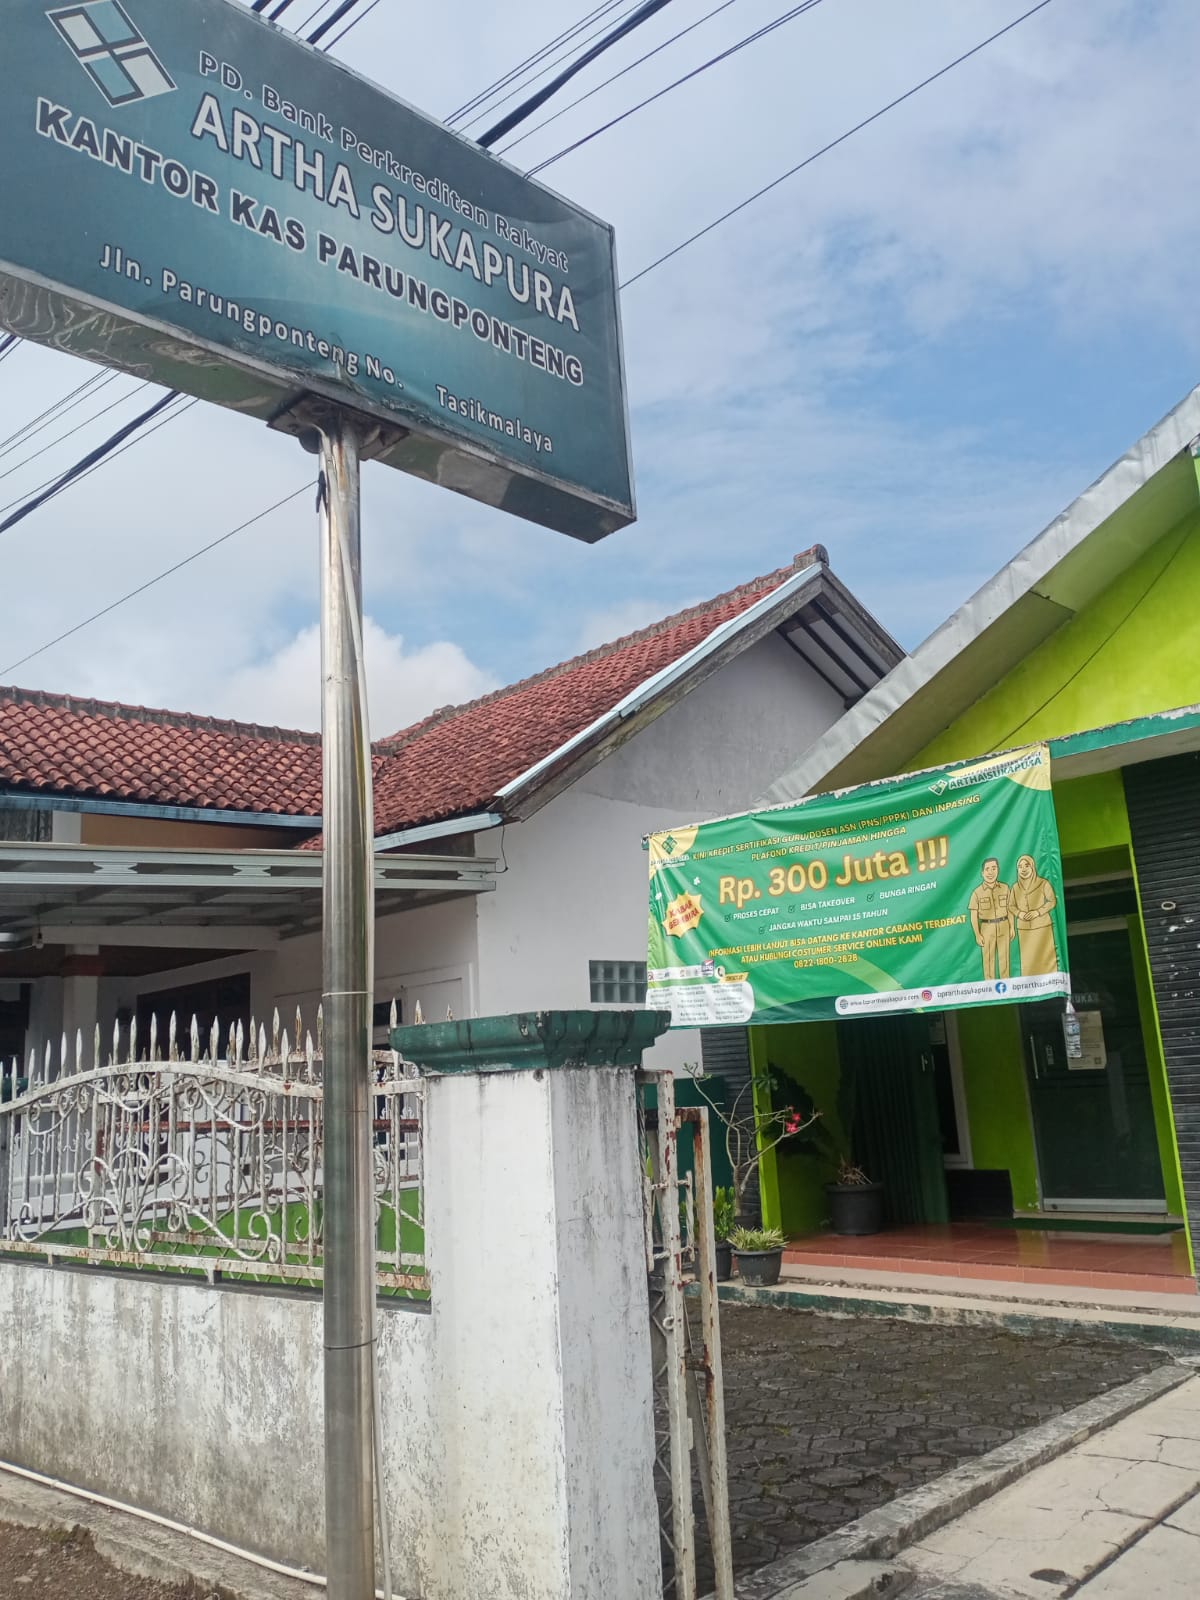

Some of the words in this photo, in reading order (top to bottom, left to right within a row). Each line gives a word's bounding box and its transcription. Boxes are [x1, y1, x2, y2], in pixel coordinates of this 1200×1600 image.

[199, 50, 254, 100] PD.
[261, 84, 334, 143] Bank
[340, 127, 489, 228] Perkreditan
[494, 214, 569, 273] Rakyat
[190, 91, 361, 220] ARTHA
[370, 182, 581, 333] SUKAPURA
[36, 96, 220, 215] KANTOR
[229, 187, 307, 253] KAS
[316, 231, 584, 386] PARUNGPONTENG
[99, 243, 152, 287] Jln.
[161, 268, 359, 376] Parungponteng
[365, 354, 404, 389] No.
[436, 383, 554, 454] Tasikmalaya
[709, 847, 735, 857] KREDIT
[735, 836, 780, 852] SERTIFIKASI
[782, 829, 838, 843] GURU/DOSEN
[839, 823, 857, 833] ASN
[858, 811, 910, 830] (PNS/PPPK)
[912, 806, 933, 818] DAN
[935, 794, 981, 813] INPASING
[751, 847, 787, 861] PLAFOND
[788, 834, 869, 854] KREDIT/PINJAMAN
[870, 826, 907, 841] HINGGA
[718, 875, 761, 909] Rp.
[767, 859, 829, 896] 300
[834, 850, 910, 887] Juta
[915, 836, 949, 872] !!!
[879, 888, 907, 899] BUNGA
[907, 881, 937, 894] RINGAN
[733, 911, 758, 920] PROSES
[759, 907, 779, 917] CEPAT
[769, 922, 796, 932] JANGKA
[797, 918, 822, 928] WAKTU
[823, 913, 852, 925] SAMPAI
[852, 912, 861, 921] 15
[862, 908, 888, 919] TAHUN
[800, 902, 817, 911] BISA
[817, 896, 855, 909] TAKEOVER
[708, 946, 742, 957] INFORMASI
[743, 943, 761, 952] LEBIH
[762, 940, 788, 950] LANJUT
[790, 938, 806, 947] BISA
[807, 934, 839, 945] DATANG
[840, 932, 851, 940] KE
[851, 927, 884, 938] KANTOR
[885, 922, 923, 934] CABANG
[924, 914, 967, 929] TERDEKAT
[741, 954, 759, 963] ATAU
[760, 949, 791, 961] HUBUNGI
[792, 946, 832, 957] COSTUMER
[833, 941, 865, 952] SERVICE
[866, 936, 897, 948] ONLINE
[898, 933, 923, 944] KAMI
